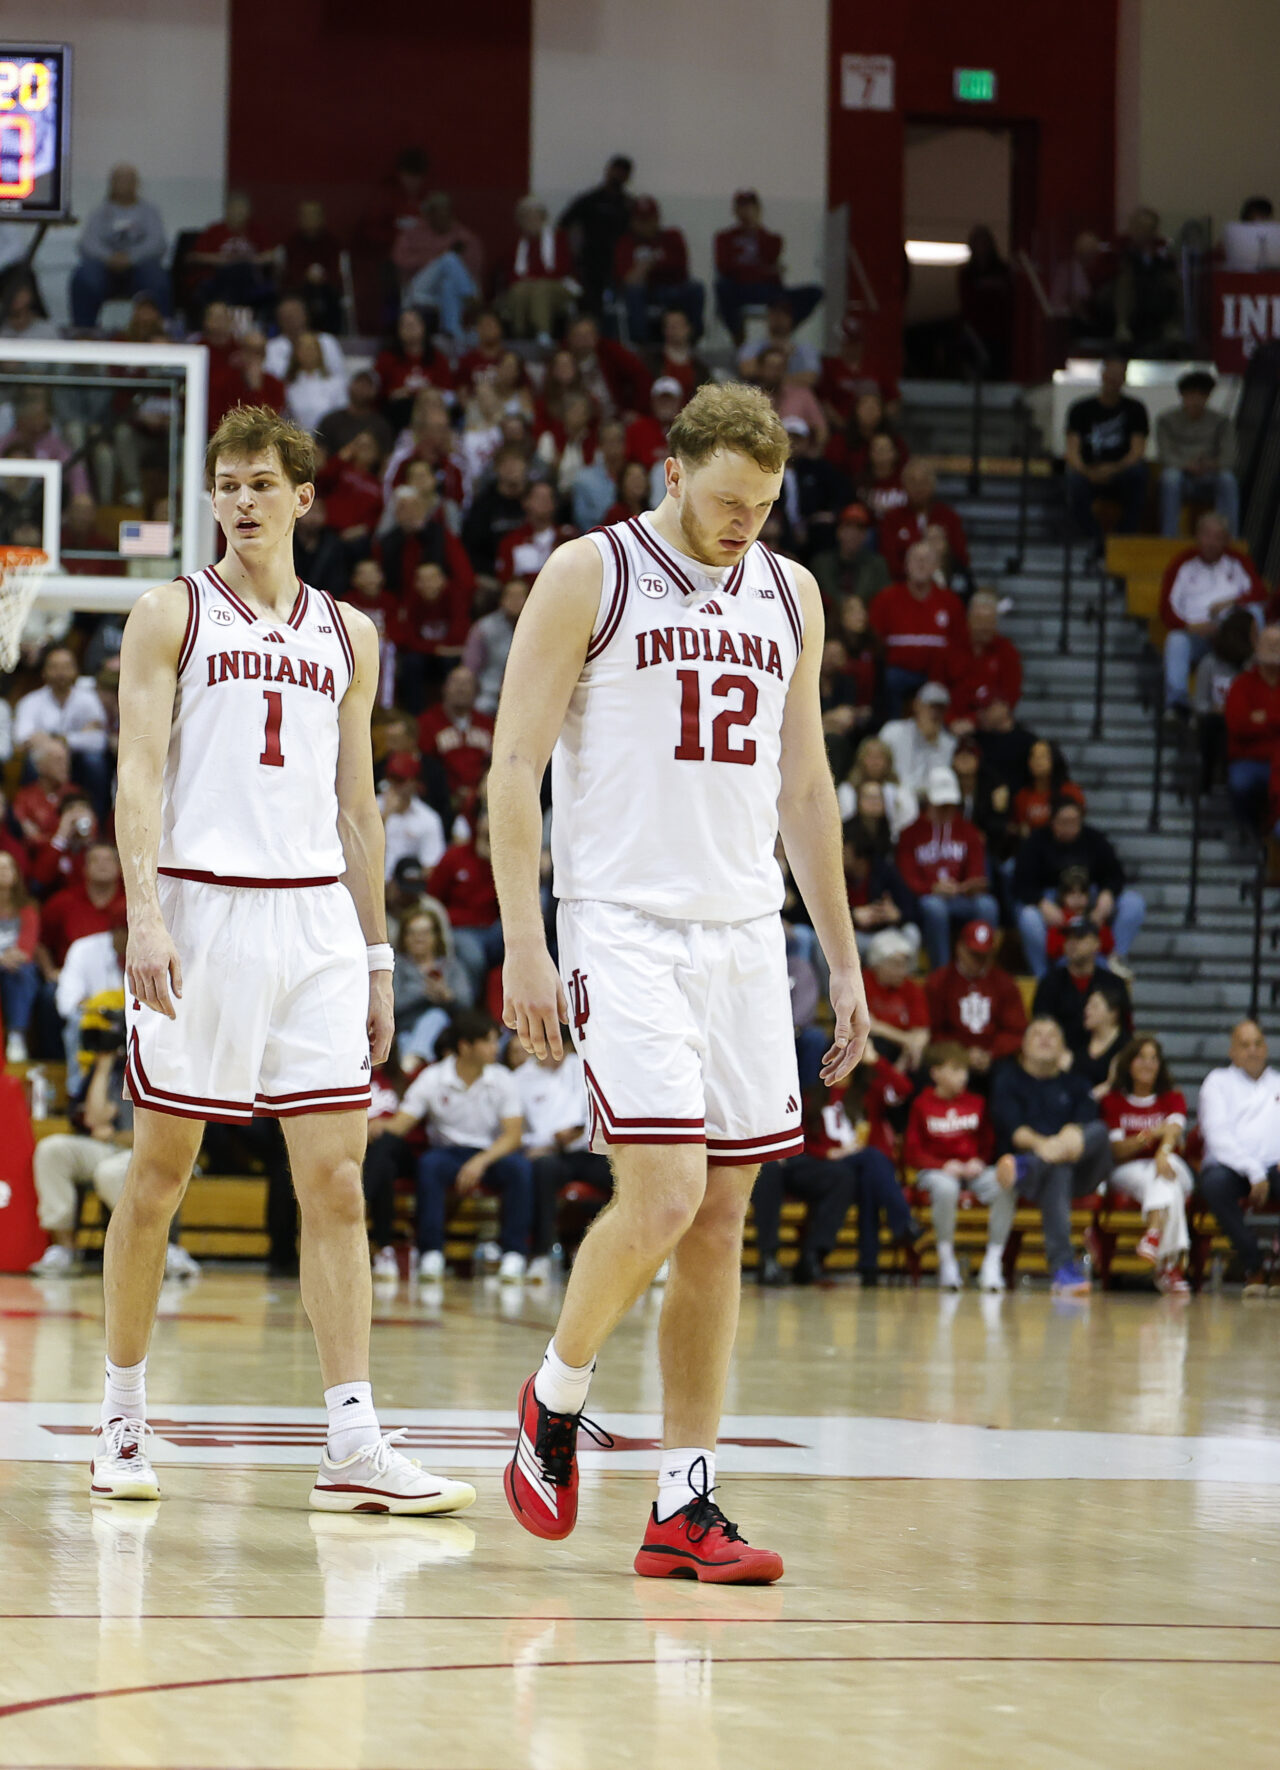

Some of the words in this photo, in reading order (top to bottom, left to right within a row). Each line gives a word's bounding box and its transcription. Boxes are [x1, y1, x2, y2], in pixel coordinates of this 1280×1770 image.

[206, 650, 336, 703] INDIANA
[635, 626, 784, 682] INDIANA
[259, 689, 285, 768] 1
[674, 669, 759, 766] 12
